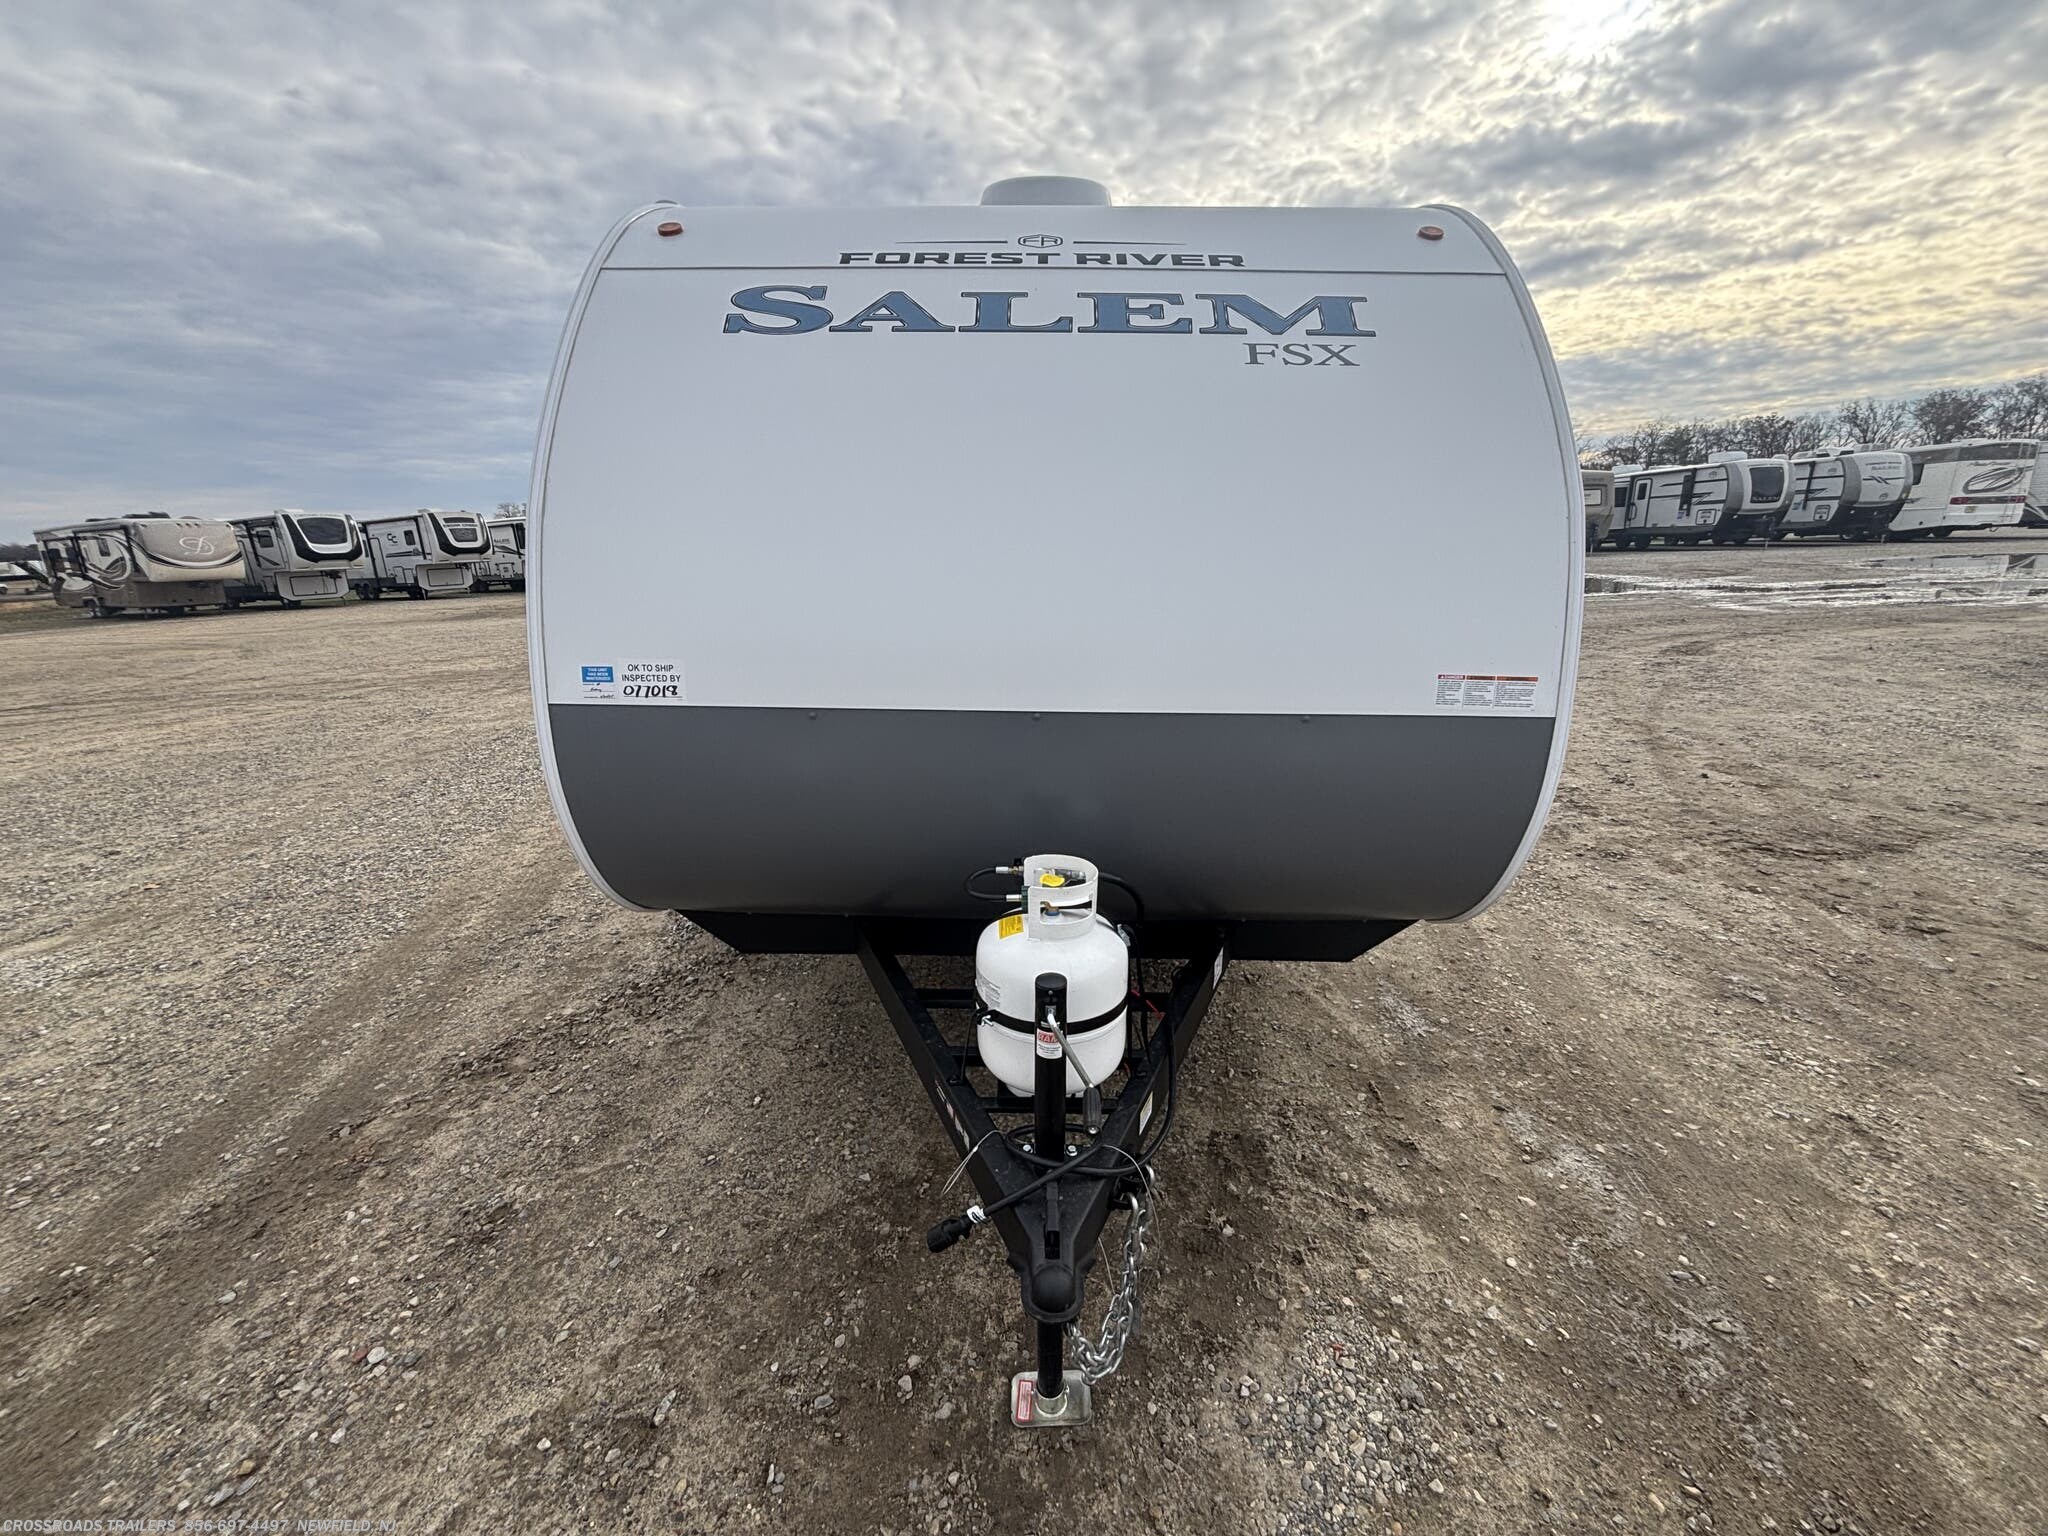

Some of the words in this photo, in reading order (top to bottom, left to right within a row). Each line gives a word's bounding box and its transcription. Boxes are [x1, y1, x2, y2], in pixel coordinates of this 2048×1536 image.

[839, 252, 1061, 265] FOREST
[1073, 253, 1246, 267] RIVER
[723, 285, 1376, 337] SALEM
[1243, 342, 1360, 366] FSX
[627, 664, 640, 672] OK
[642, 664, 653, 672] TO
[655, 664, 674, 672] SHIP
[622, 674, 668, 682] INSPECTED
